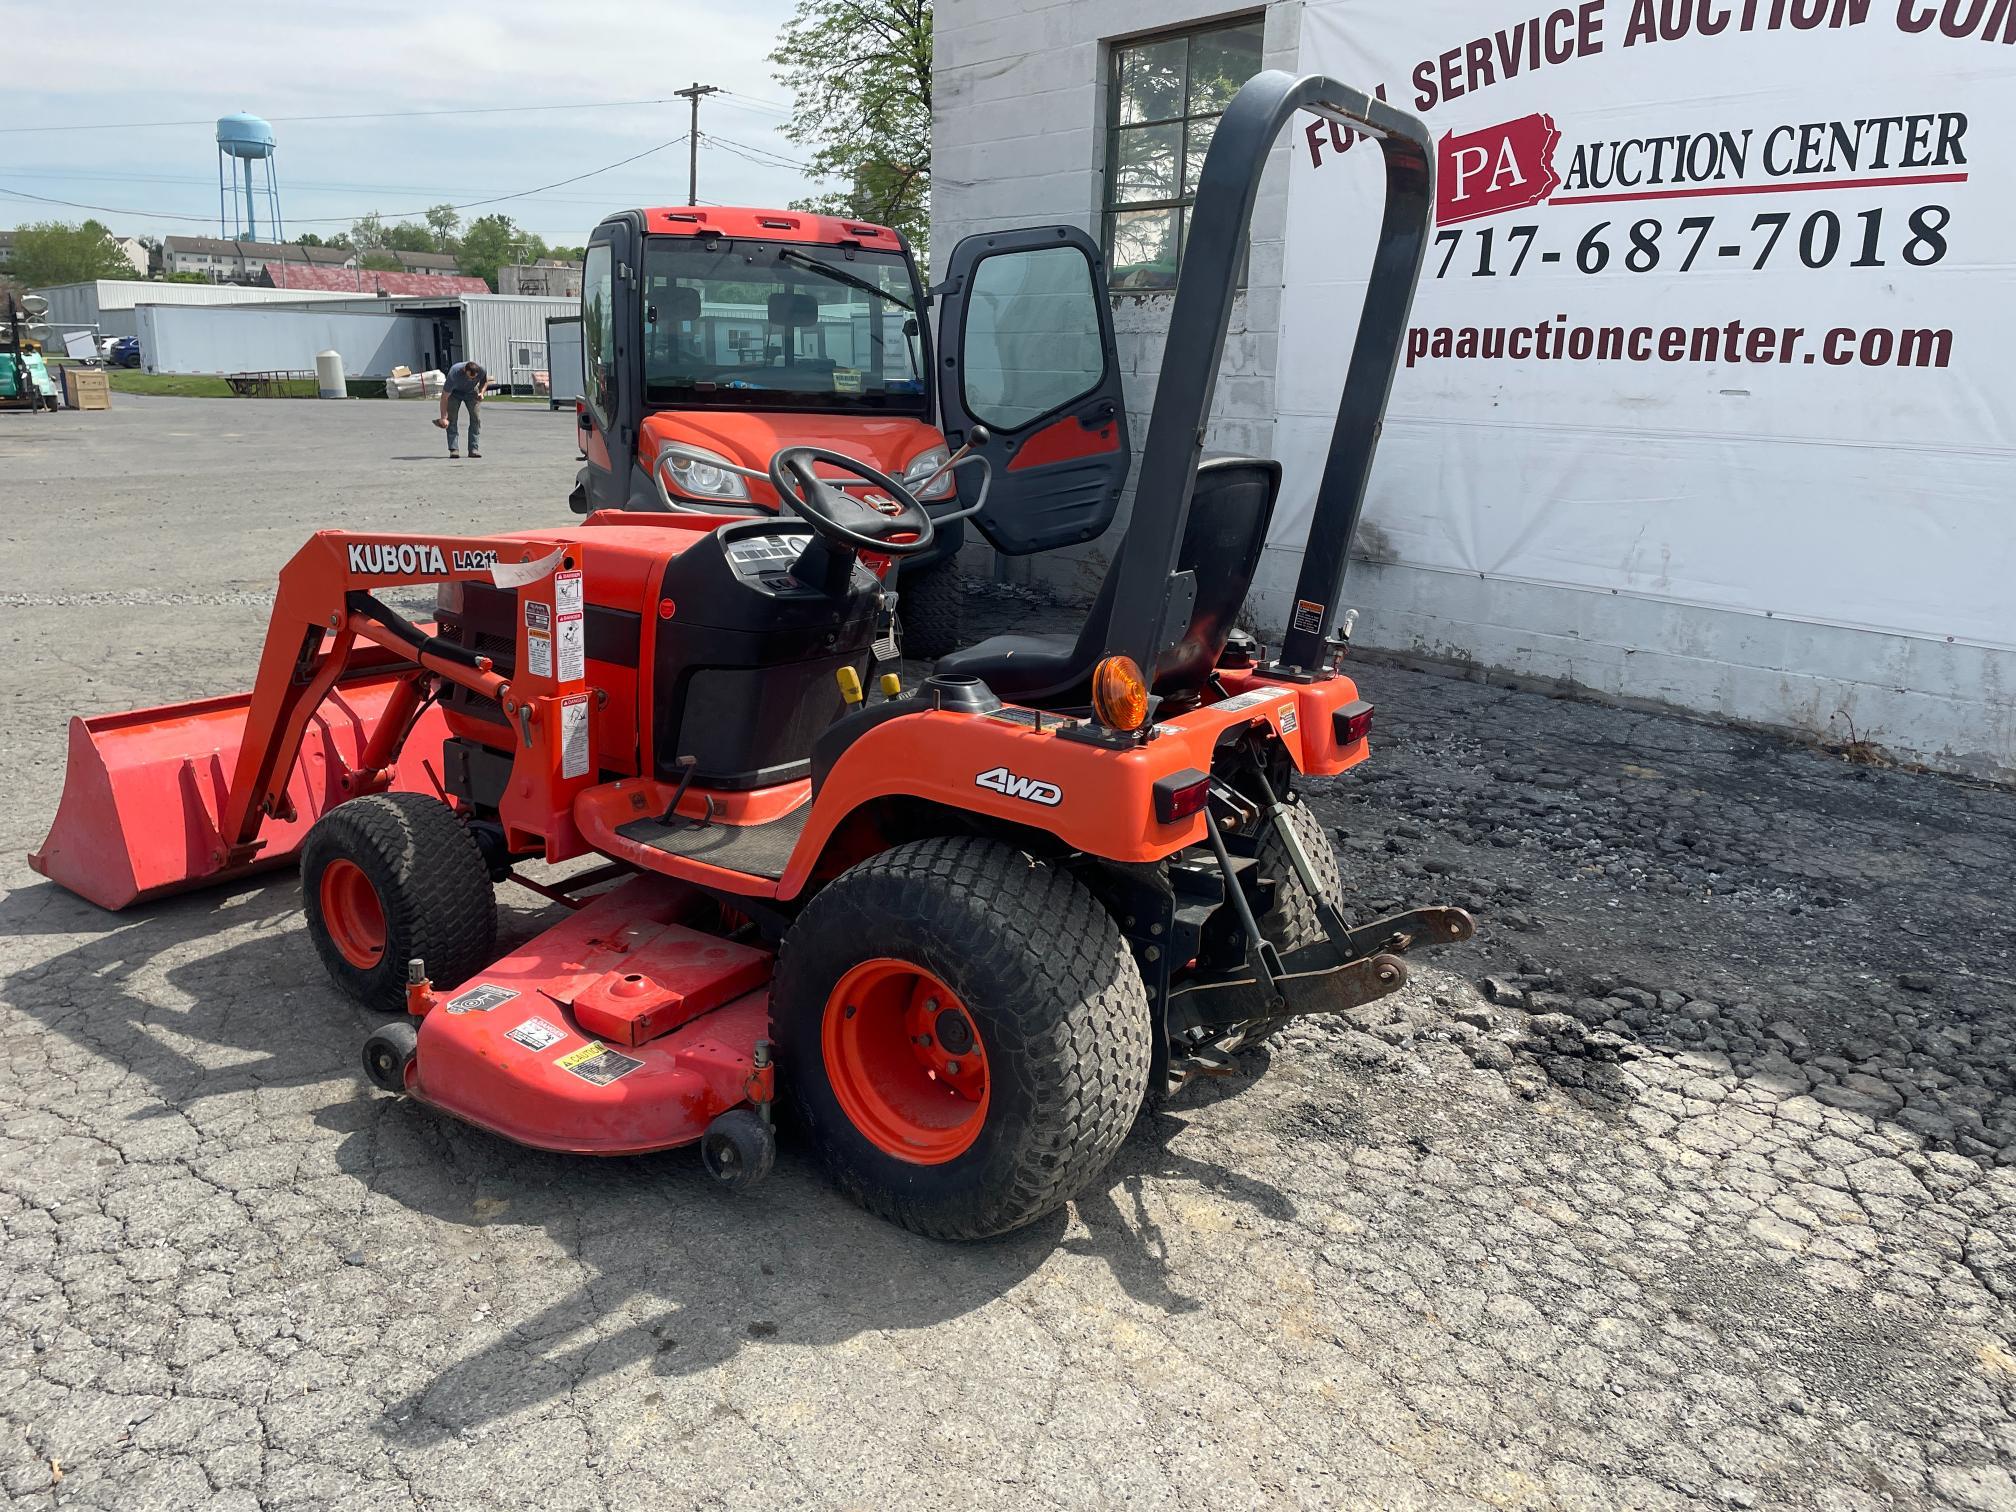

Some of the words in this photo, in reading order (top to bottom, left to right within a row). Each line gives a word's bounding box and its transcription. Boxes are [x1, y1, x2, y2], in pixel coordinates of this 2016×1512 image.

[1305, 82, 1388, 169] FU
[1412, 0, 1605, 112] SERVICE
[1450, 136, 1528, 203] PA
[1563, 128, 1754, 191] AUCTION
[1762, 112, 1968, 177] CENTER
[1434, 205, 1951, 279] 717-687-7018
[1405, 313, 1953, 368] paauctioncenter.com
[348, 544, 450, 575] KUBOTA
[975, 766, 1063, 807] 4WD
[570, 1043, 605, 1064] CAUTION
